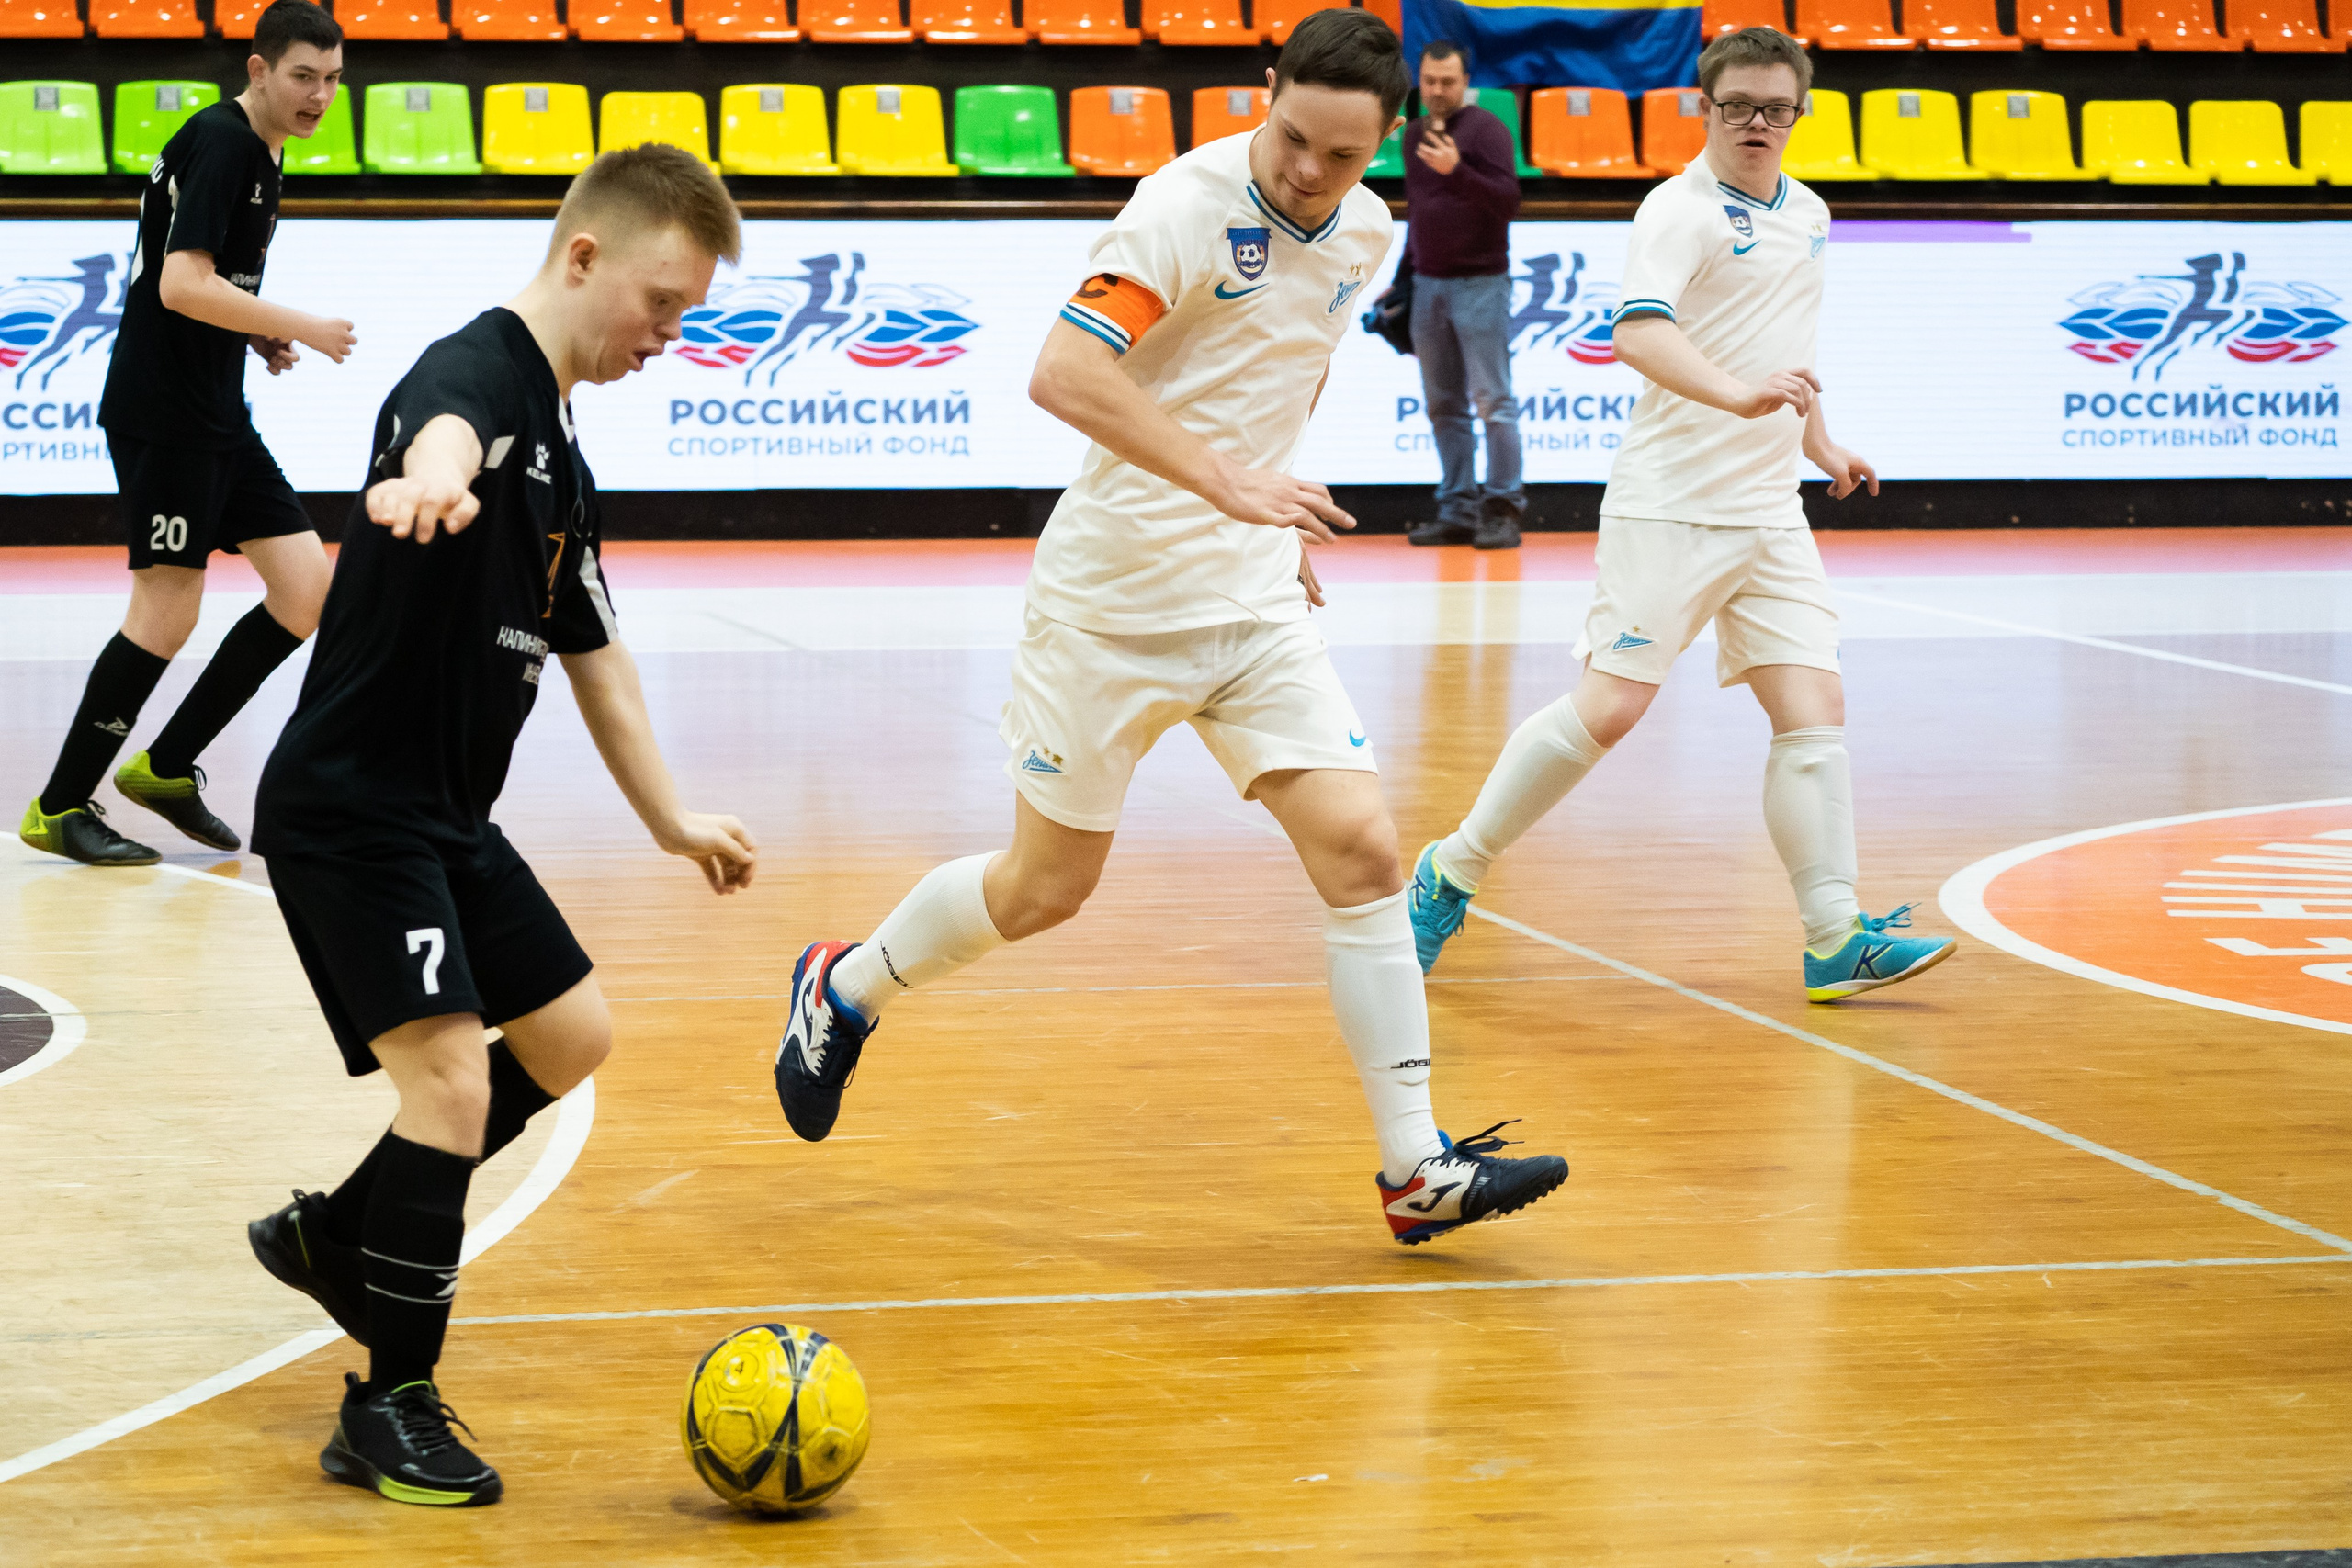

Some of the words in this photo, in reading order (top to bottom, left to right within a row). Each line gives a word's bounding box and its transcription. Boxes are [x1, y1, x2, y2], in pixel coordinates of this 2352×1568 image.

[670, 390, 970, 425] РОССИЙСКИЙ
[2064, 384, 2339, 418] РОССИЙСКИЙ
[3, 442, 112, 461] РТИВН
[668, 433, 874, 457] СПОРТИВНЫЙ
[883, 435, 970, 457] ФОНД
[2062, 424, 2249, 447] СПОРТИВНЫЙ
[2258, 427, 2339, 448] ФОНД
[150, 514, 188, 552] 20
[406, 927, 445, 995] 7
